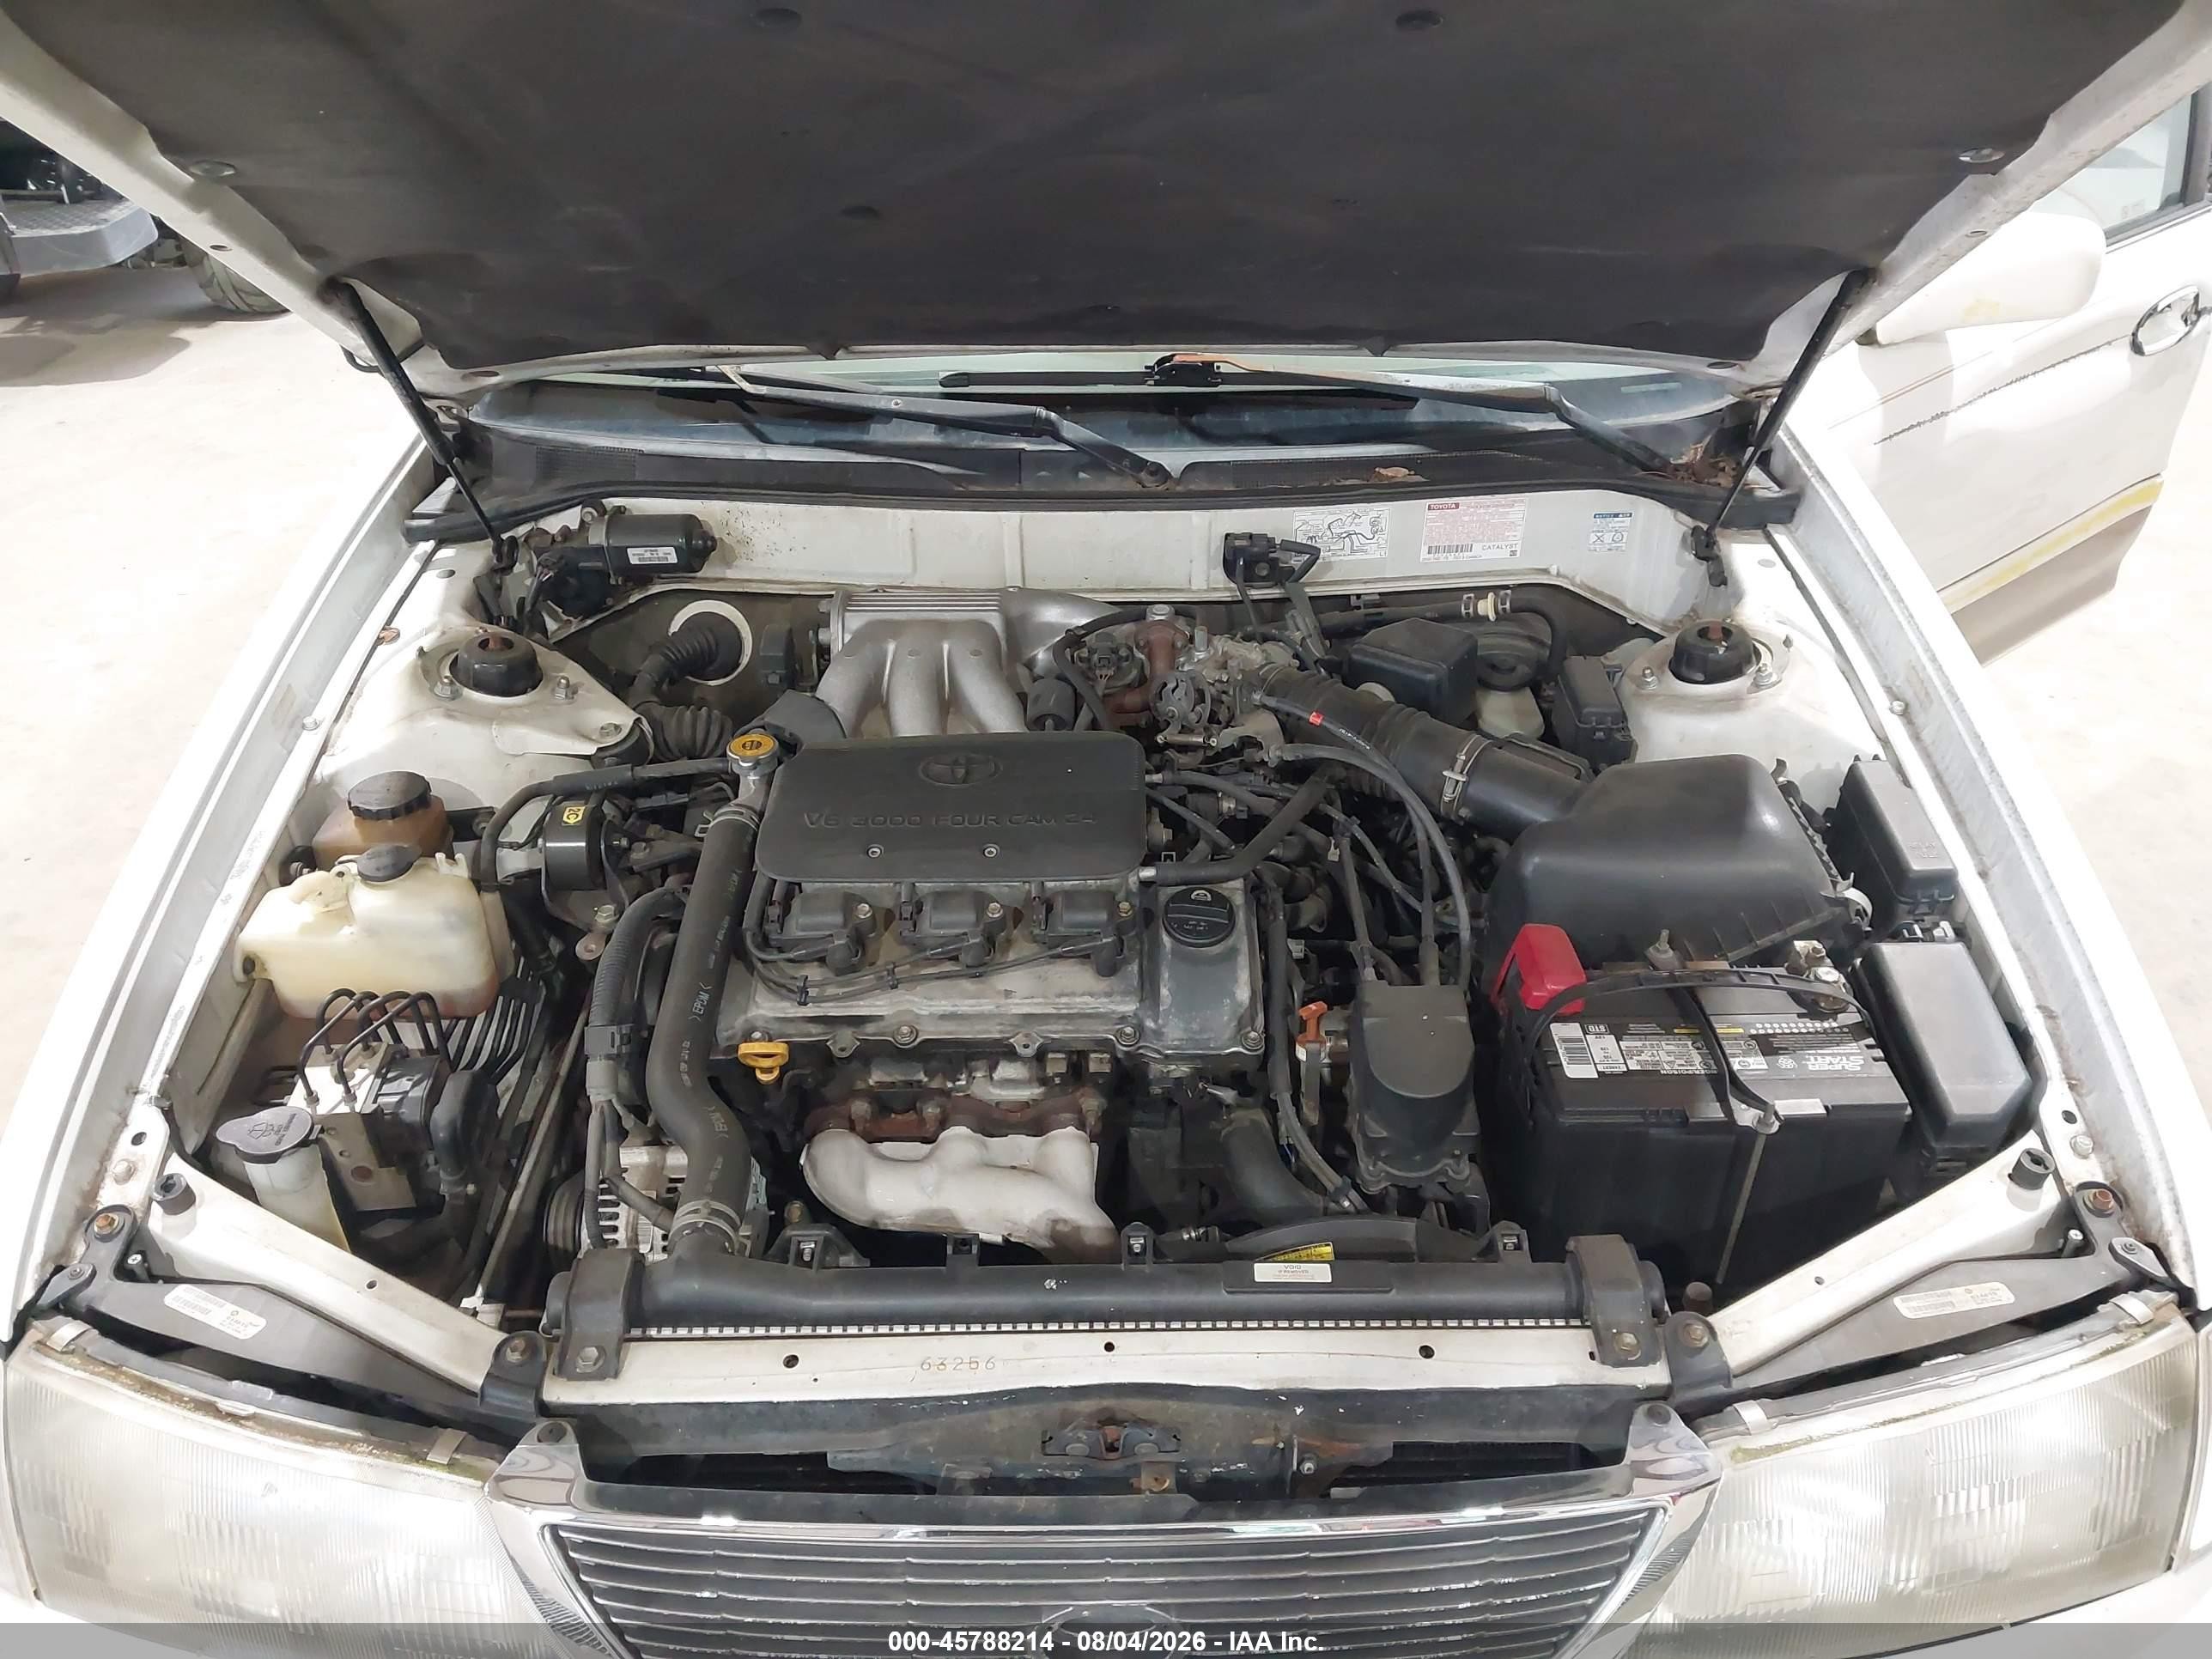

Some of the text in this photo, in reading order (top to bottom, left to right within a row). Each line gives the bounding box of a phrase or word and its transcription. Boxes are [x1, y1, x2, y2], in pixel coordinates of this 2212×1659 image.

[566, 807, 580, 821] 2C
[803, 811, 840, 828] V6
[851, 814, 922, 827] 3000
[932, 814, 1001, 828] FOUR
[1006, 813, 1057, 826] CAM
[1808, 1063, 1861, 1072] SUPER
